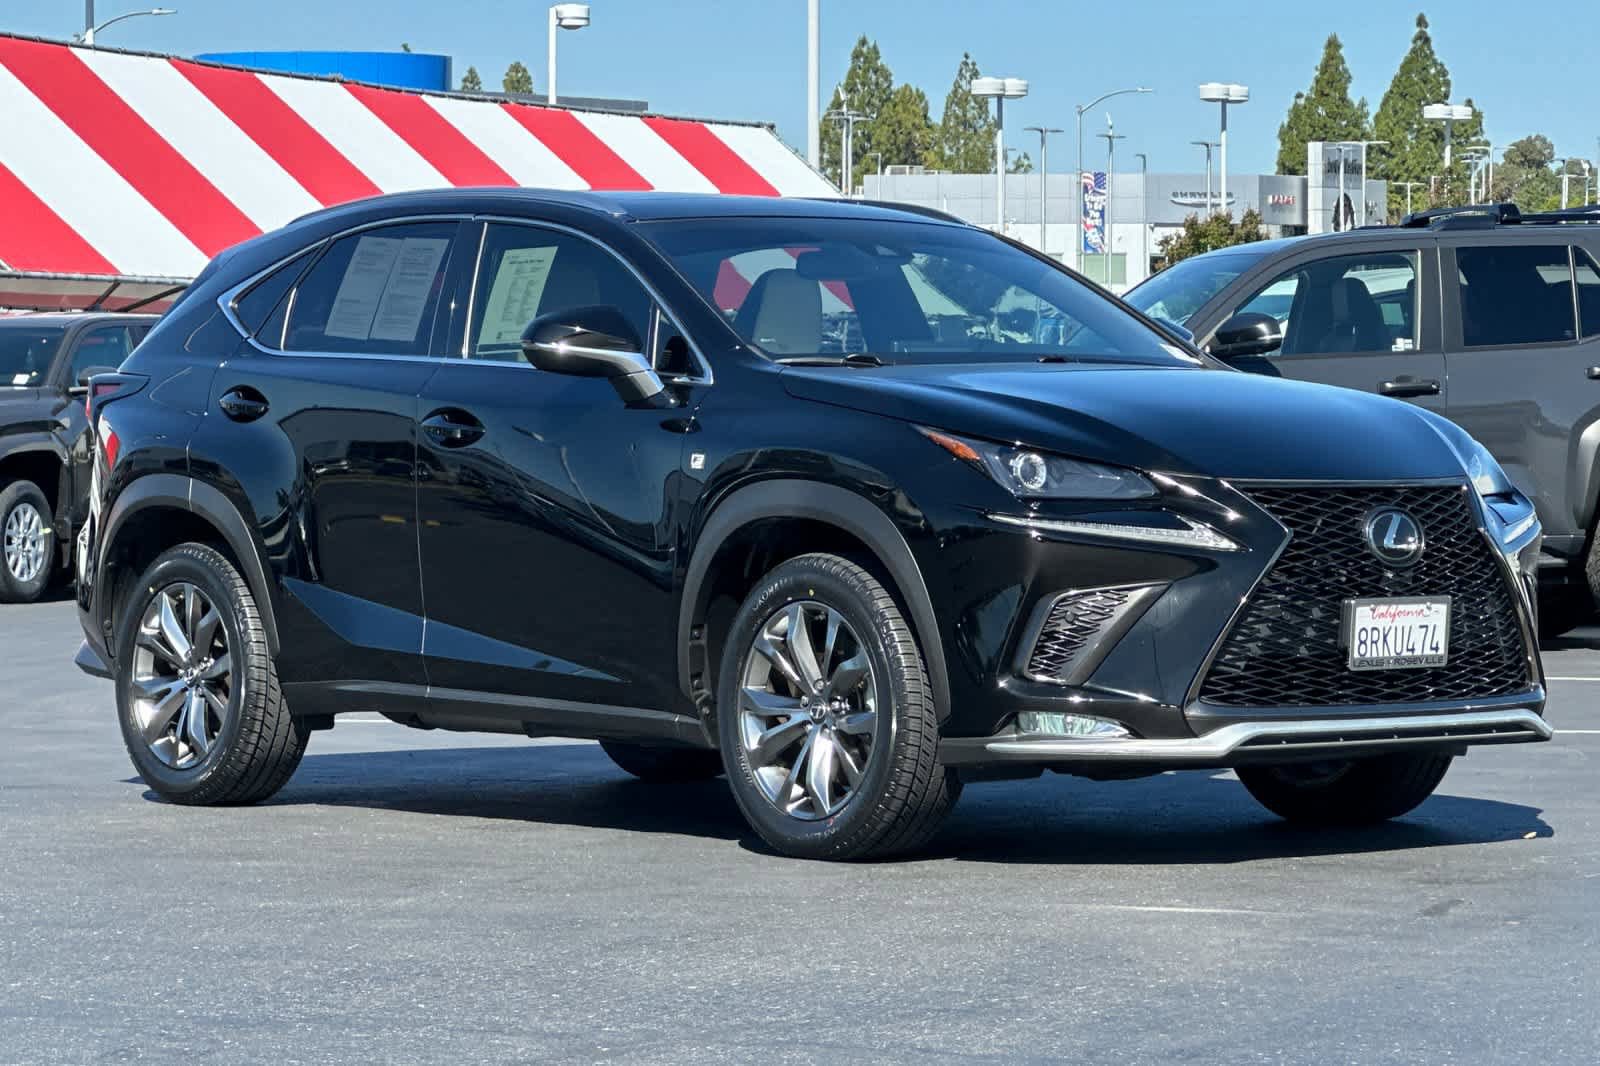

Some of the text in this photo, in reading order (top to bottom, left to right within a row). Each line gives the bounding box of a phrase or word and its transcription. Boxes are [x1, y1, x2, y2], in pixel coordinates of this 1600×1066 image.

[1370, 604, 1425, 624] California
[1357, 624, 1440, 657] 8RKU474
[1393, 656, 1444, 666] ROSEVILLE
